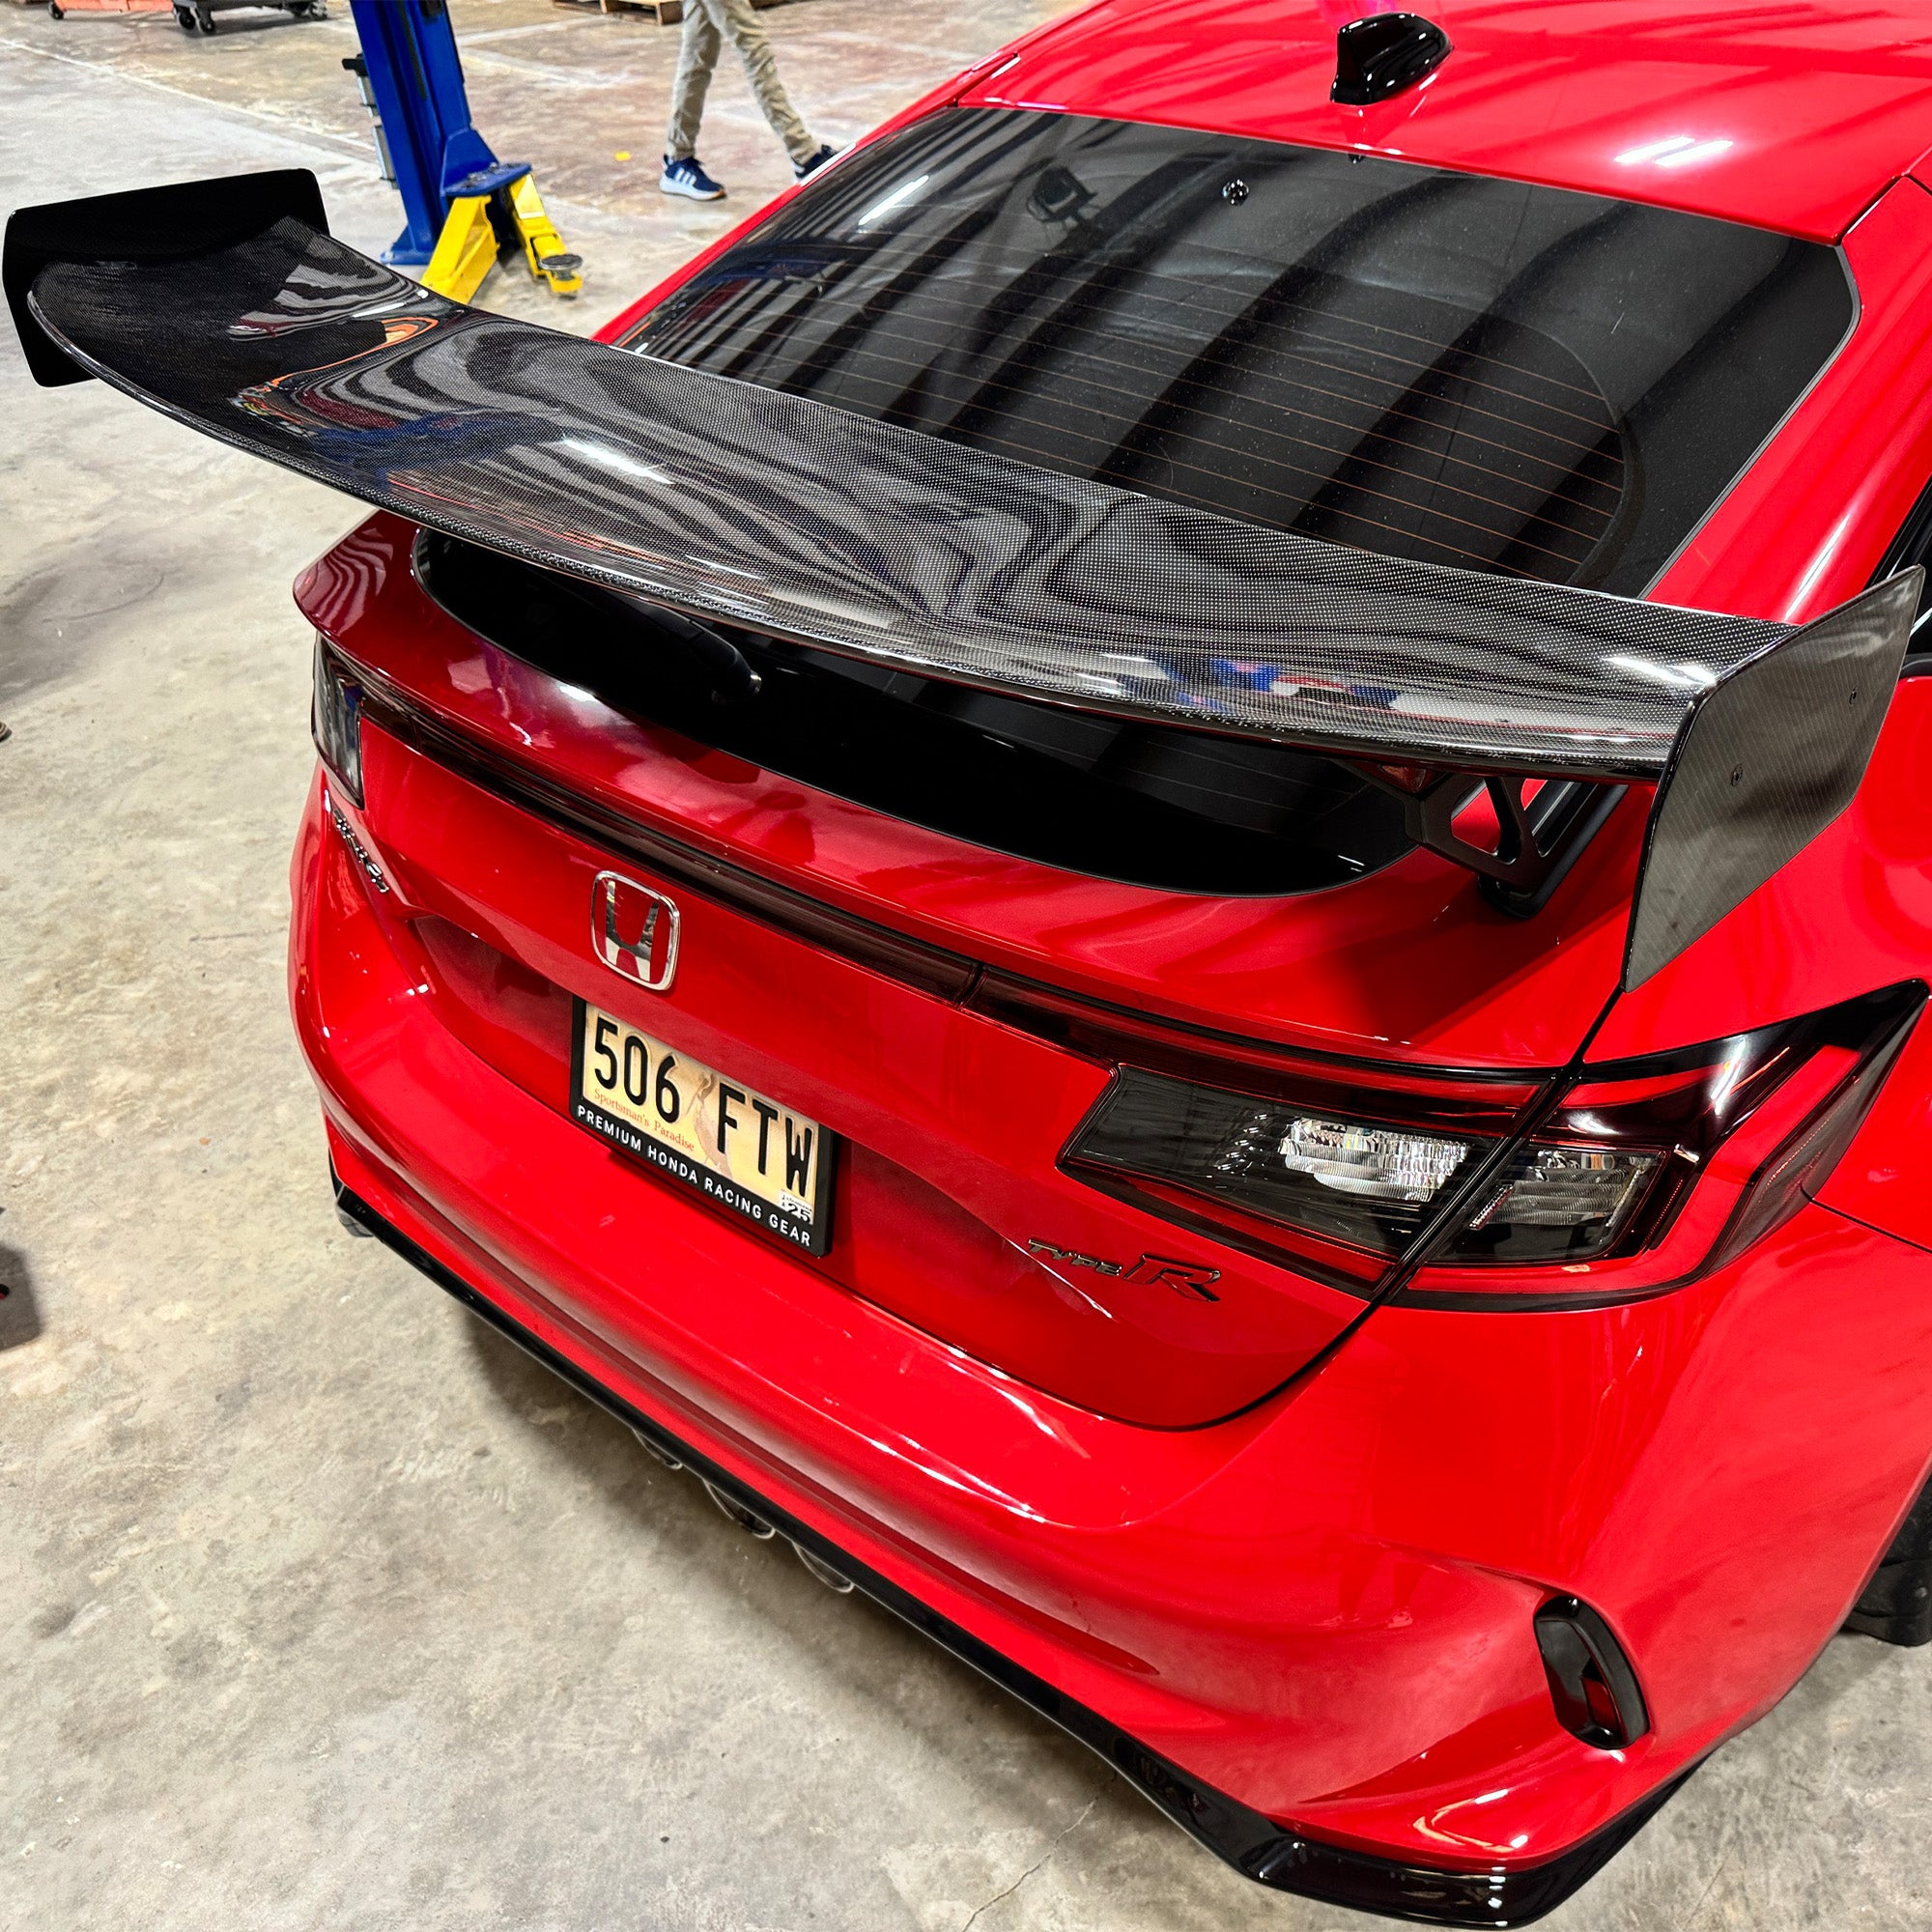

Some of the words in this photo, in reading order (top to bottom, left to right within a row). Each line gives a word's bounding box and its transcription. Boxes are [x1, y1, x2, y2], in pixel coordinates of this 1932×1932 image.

[594, 1016, 680, 1123] 506
[717, 1082, 812, 1198] FTW
[594, 1088, 650, 1127] Sportsman's
[654, 1120, 695, 1151] Paradise
[578, 1104, 641, 1151] PREMIUM
[648, 1144, 697, 1184] HONDA
[704, 1177, 762, 1219] RACING
[769, 1213, 810, 1247] GEAR
[1028, 1238, 1122, 1277] TYPE
[1122, 1253, 1221, 1302] R
